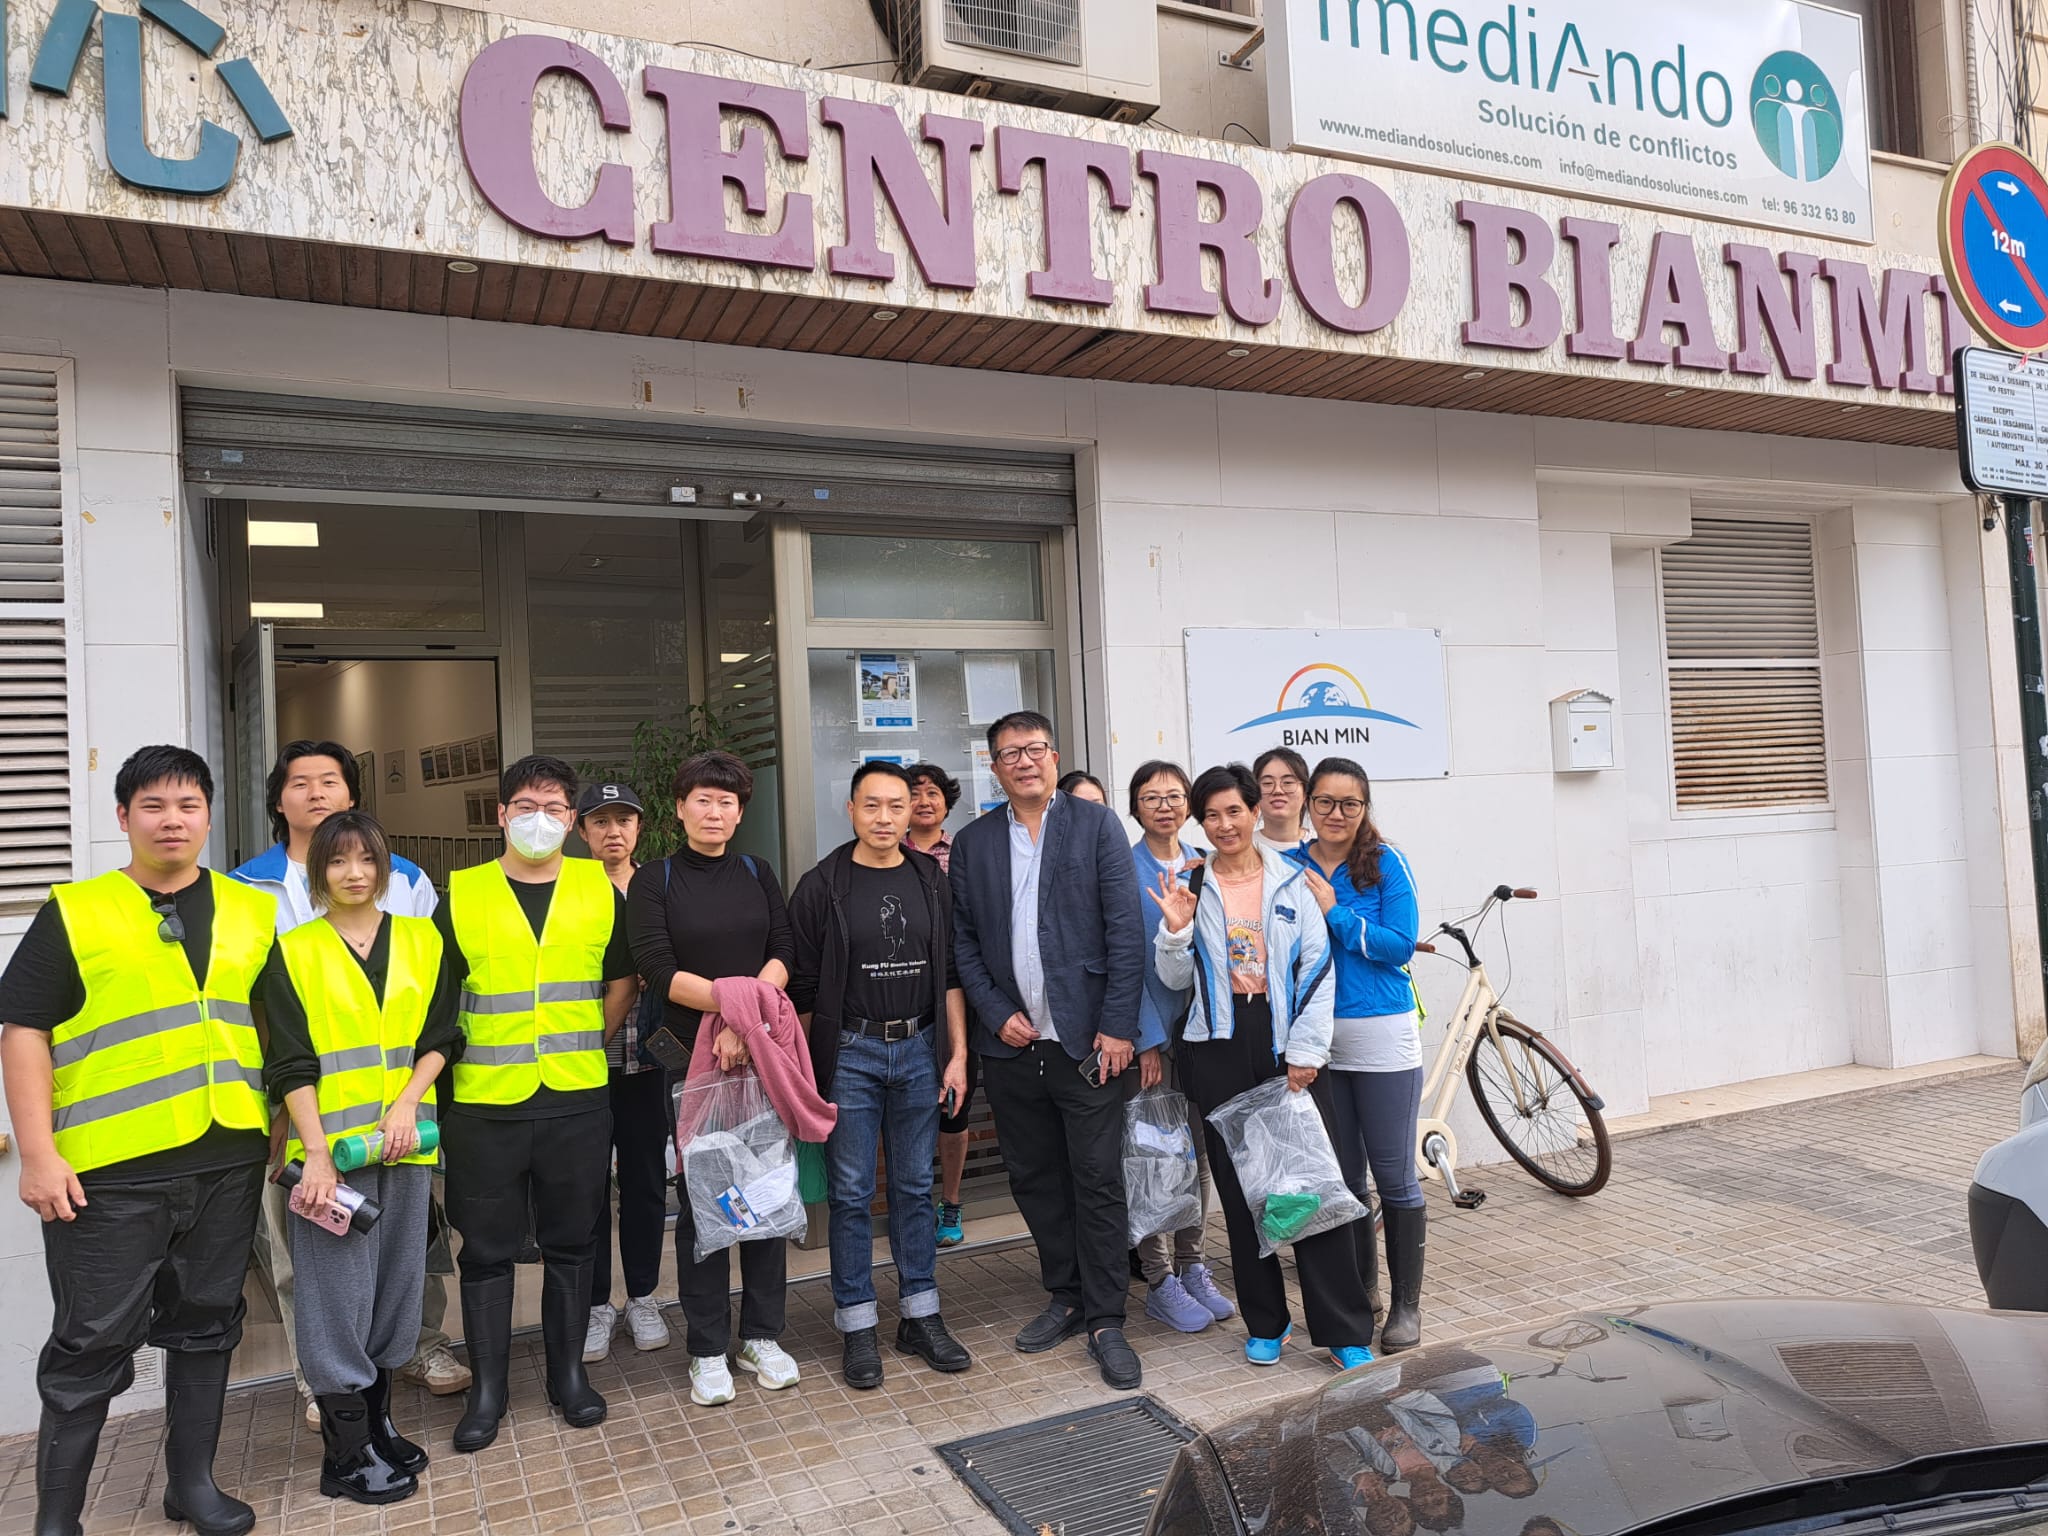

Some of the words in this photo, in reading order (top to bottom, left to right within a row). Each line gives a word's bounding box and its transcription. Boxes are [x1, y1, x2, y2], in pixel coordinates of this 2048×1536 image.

[0, 0, 292, 196] 心
[1478, 98, 1586, 143] Solución
[1593, 116, 1622, 149] de
[1629, 127, 1738, 171] conflictos
[1319, 117, 1543, 170] www.mediandosoluciones.com
[1559, 157, 1749, 206] info@mediandosoluciones.com
[1762, 196, 1780, 213] tel:
[1783, 199, 1798, 215] 96
[1801, 202, 1822, 220] 332
[1825, 206, 1840, 222] 63
[1842, 209, 1856, 225] 80
[459, 33, 1412, 333] CENTRO
[1455, 199, 1971, 396] BIANMI
[1992, 228, 2027, 259] 12m
[1283, 728, 1328, 747] BIAN
[1335, 727, 1370, 745] MIN
[602, 785, 619, 800] S
